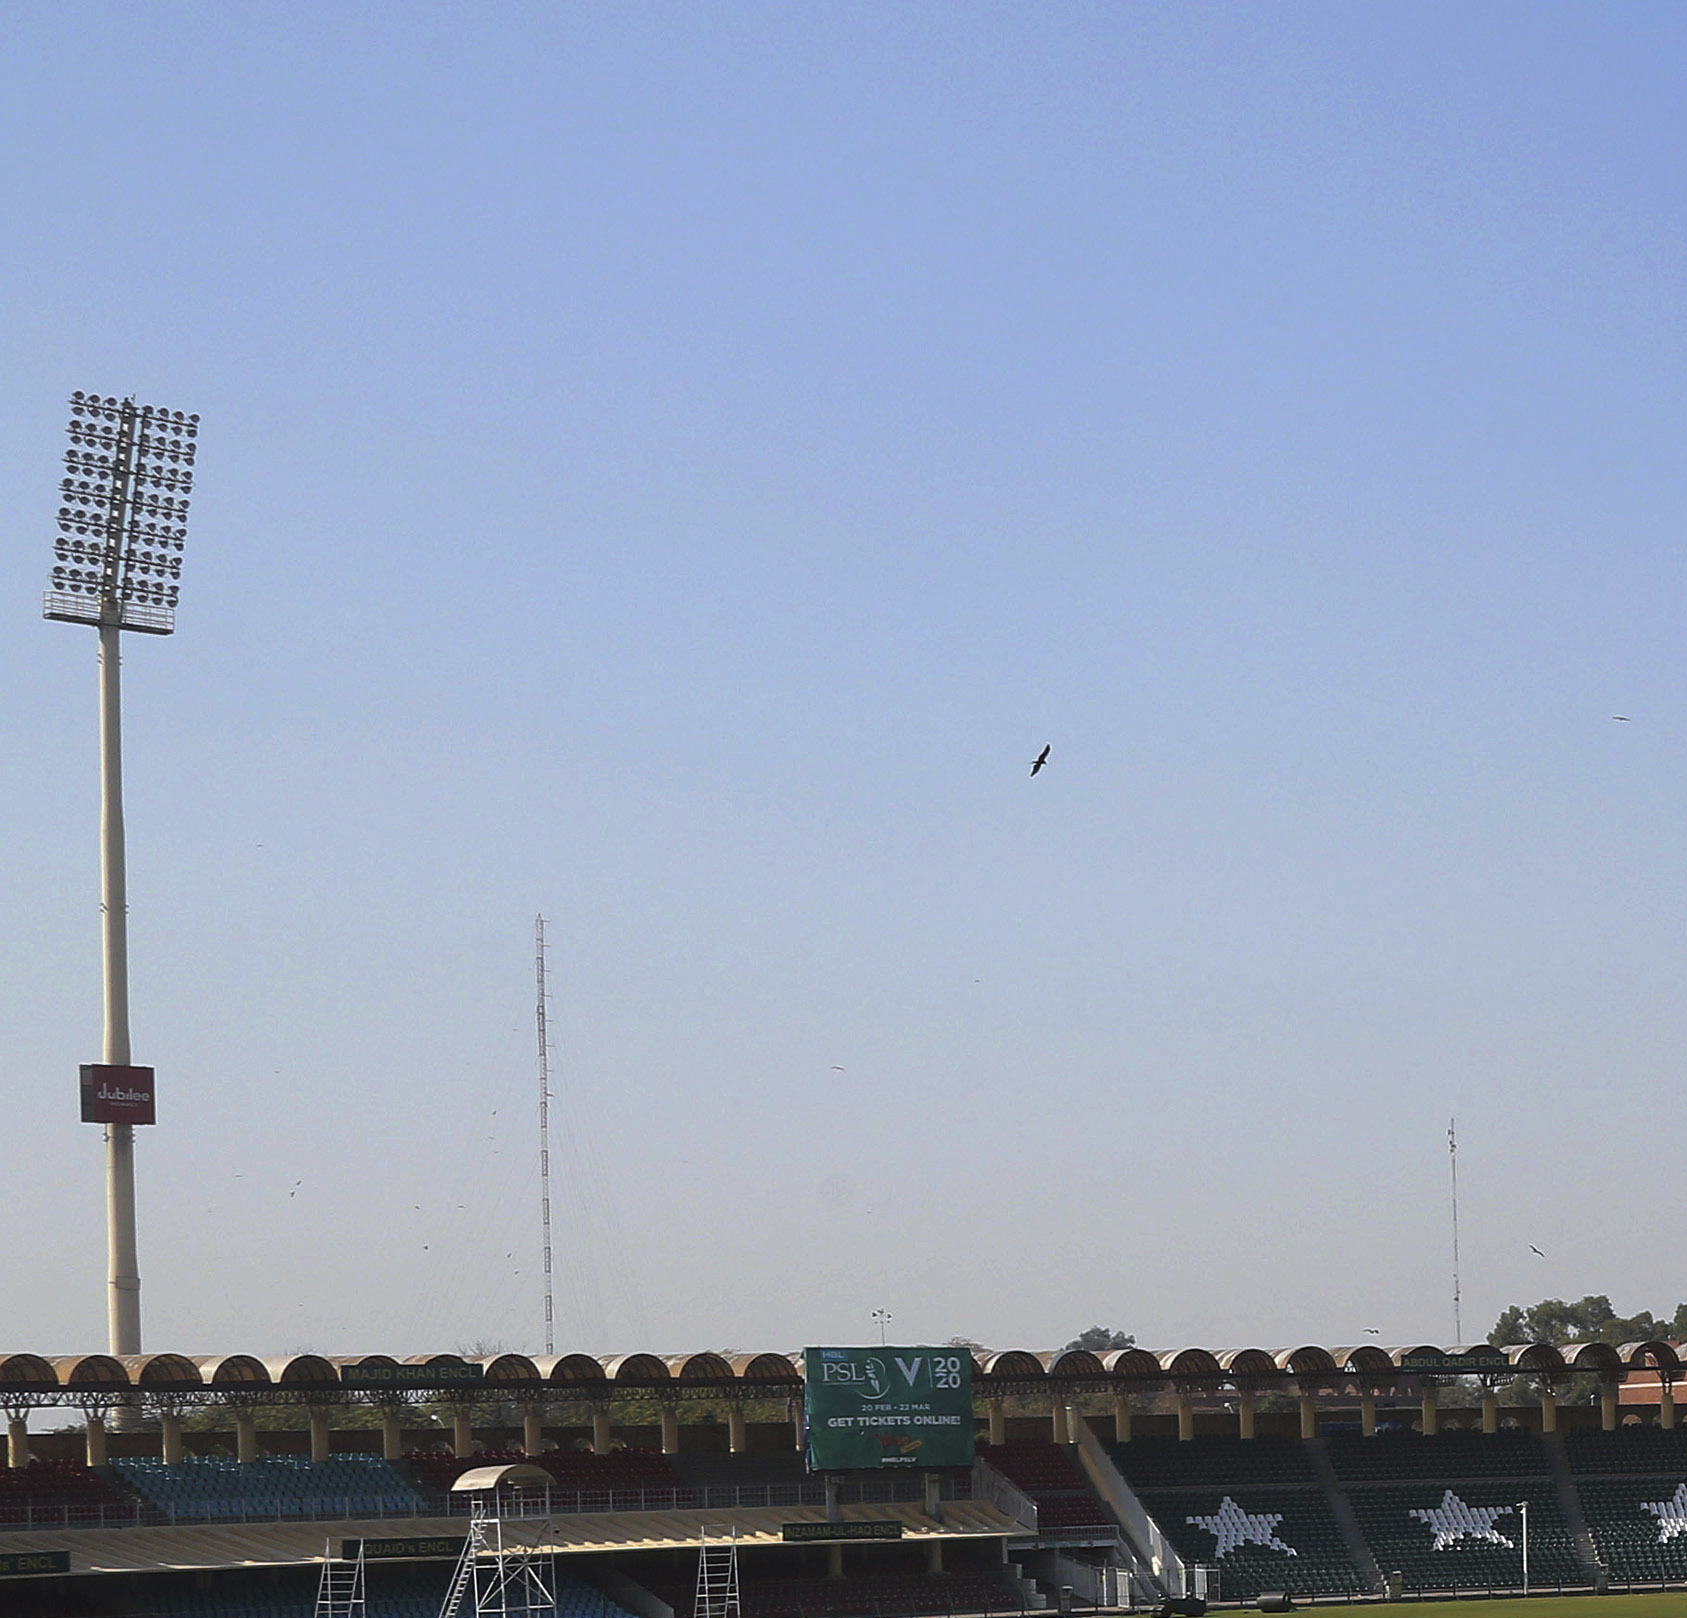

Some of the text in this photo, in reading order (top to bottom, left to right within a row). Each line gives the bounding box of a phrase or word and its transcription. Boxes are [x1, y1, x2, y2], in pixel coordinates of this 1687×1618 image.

[98, 1083, 150, 1101] Jubilee
[933, 1357, 961, 1372] 20
[1403, 1357, 1507, 1367] ABDUL QADIR ENCL
[348, 1367, 477, 1380] MAJID KHAN ENCL
[822, 1363, 866, 1382] PSL
[894, 1357, 922, 1387] V
[935, 1372, 961, 1388] 20
[911, 1403, 930, 1411] MAR
[828, 1415, 961, 1427] GET TICKETS ONLINE!
[873, 1525, 900, 1535] ENCL
[420, 1542, 453, 1553] ENCL
